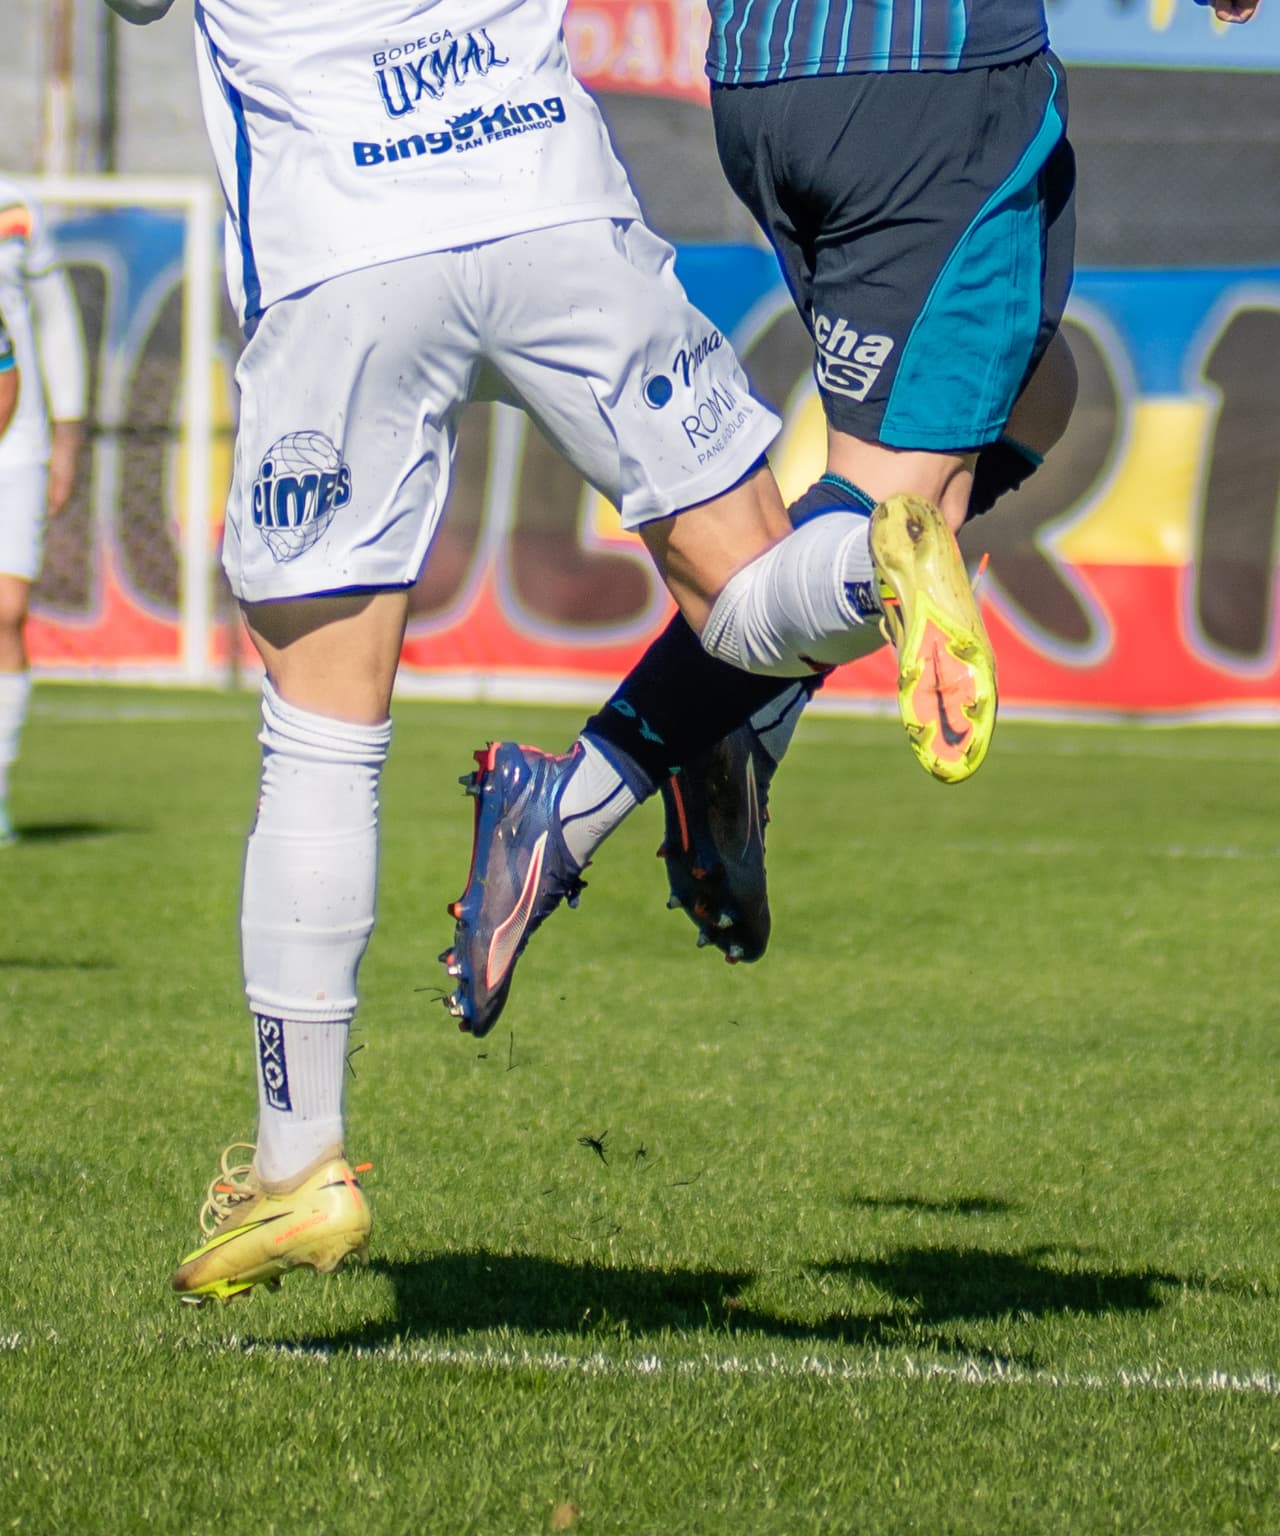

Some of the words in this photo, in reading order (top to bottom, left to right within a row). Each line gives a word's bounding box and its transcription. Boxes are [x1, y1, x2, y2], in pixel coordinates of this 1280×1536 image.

[372, 28, 453, 67] BODEGA
[374, 27, 510, 120] UXMAL
[455, 137, 483, 153] SAN
[487, 120, 553, 146] FERNANDO
[812, 308, 894, 366] cha
